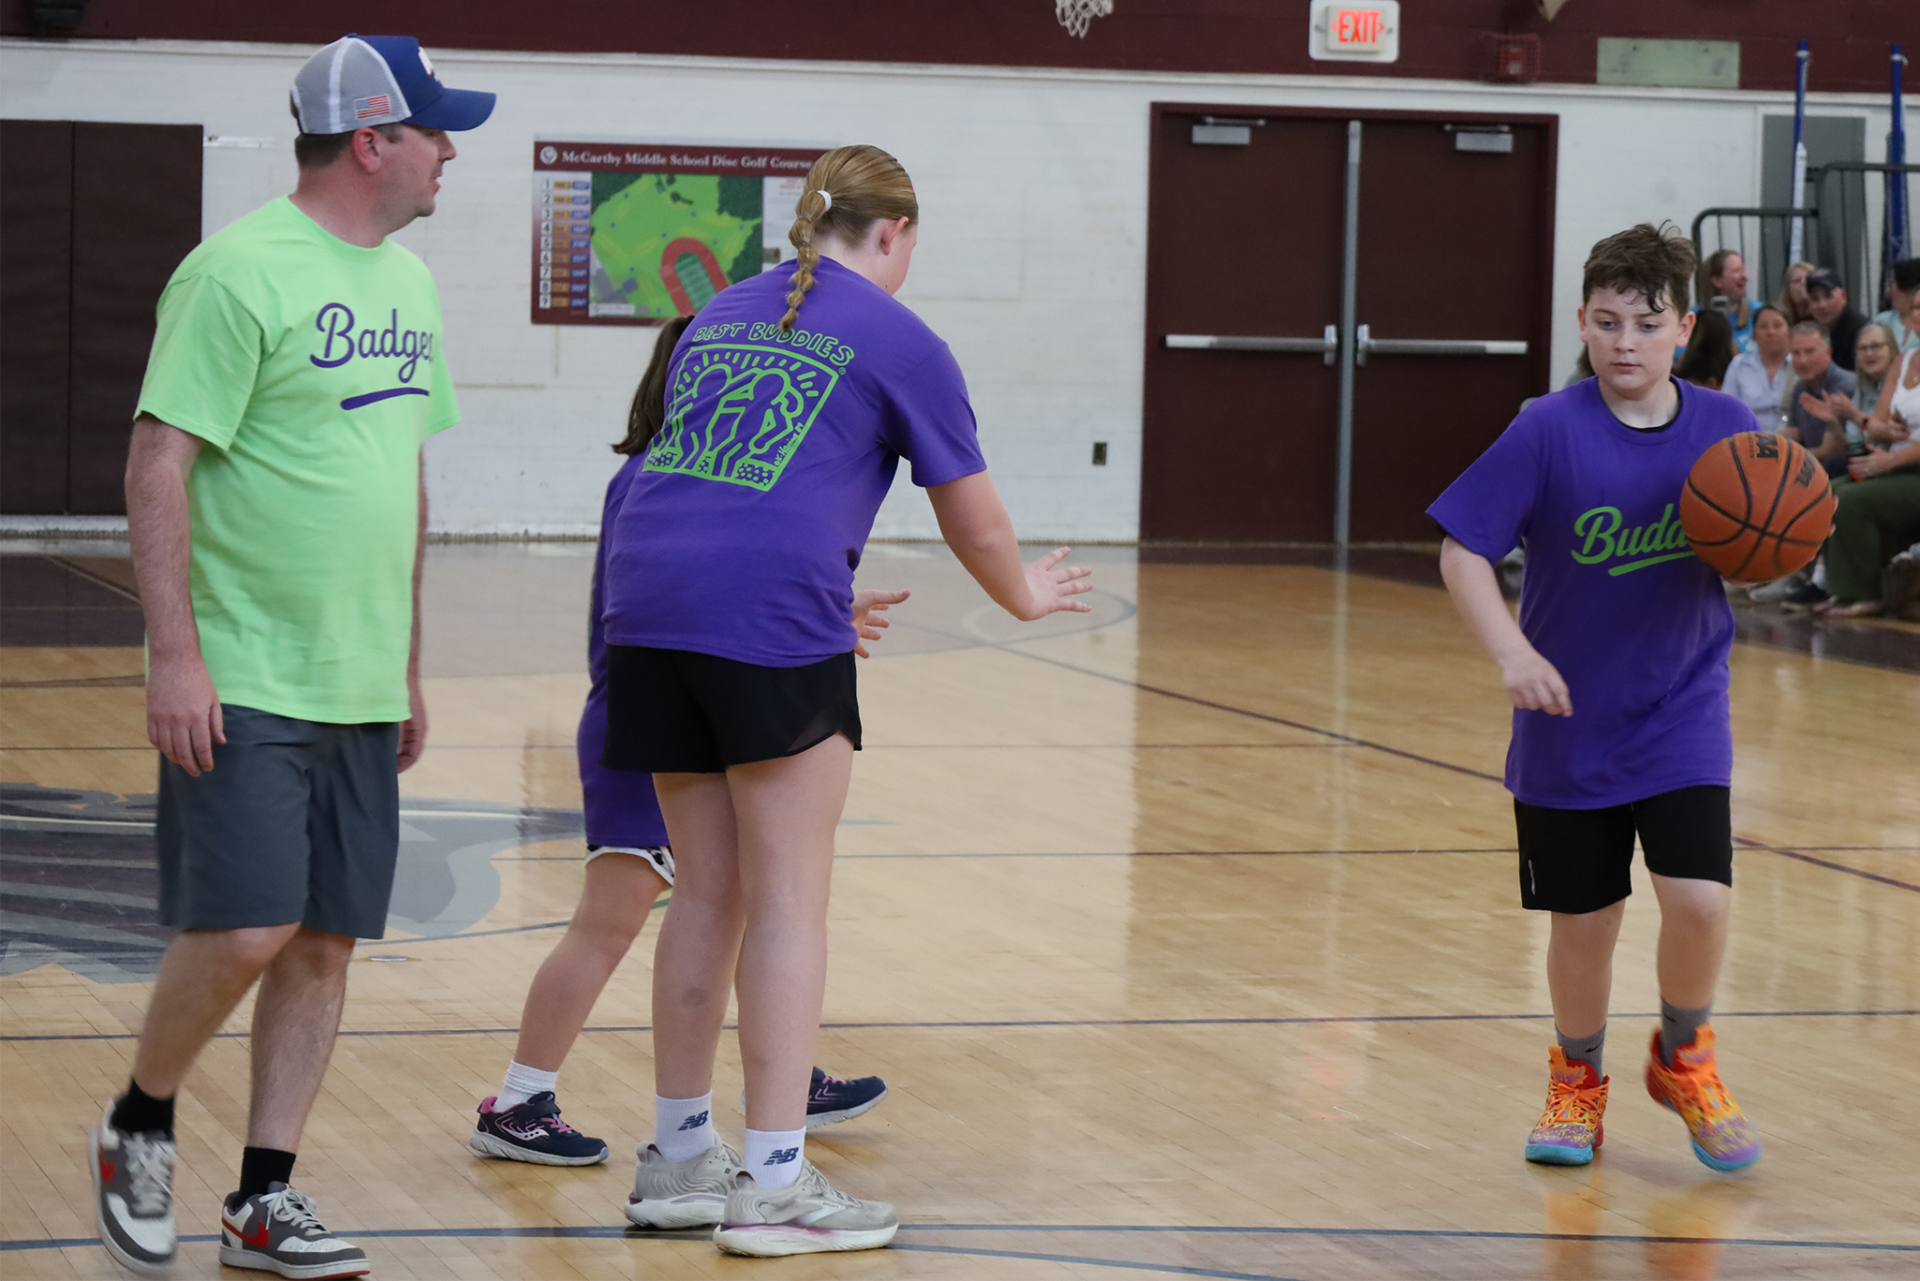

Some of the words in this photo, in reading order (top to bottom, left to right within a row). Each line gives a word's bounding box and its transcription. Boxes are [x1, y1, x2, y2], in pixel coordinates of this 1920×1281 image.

[1337, 9, 1382, 43] EXIT
[561, 150, 621, 167] McCarthy
[624, 152, 667, 166] Middle
[669, 154, 709, 166] School
[712, 155, 738, 167] Disc
[740, 156, 767, 168] Golf
[770, 157, 812, 169] Course
[692, 323, 746, 342] BEST
[748, 322, 855, 366] BUDDIES
[1571, 503, 1687, 564] Budd
